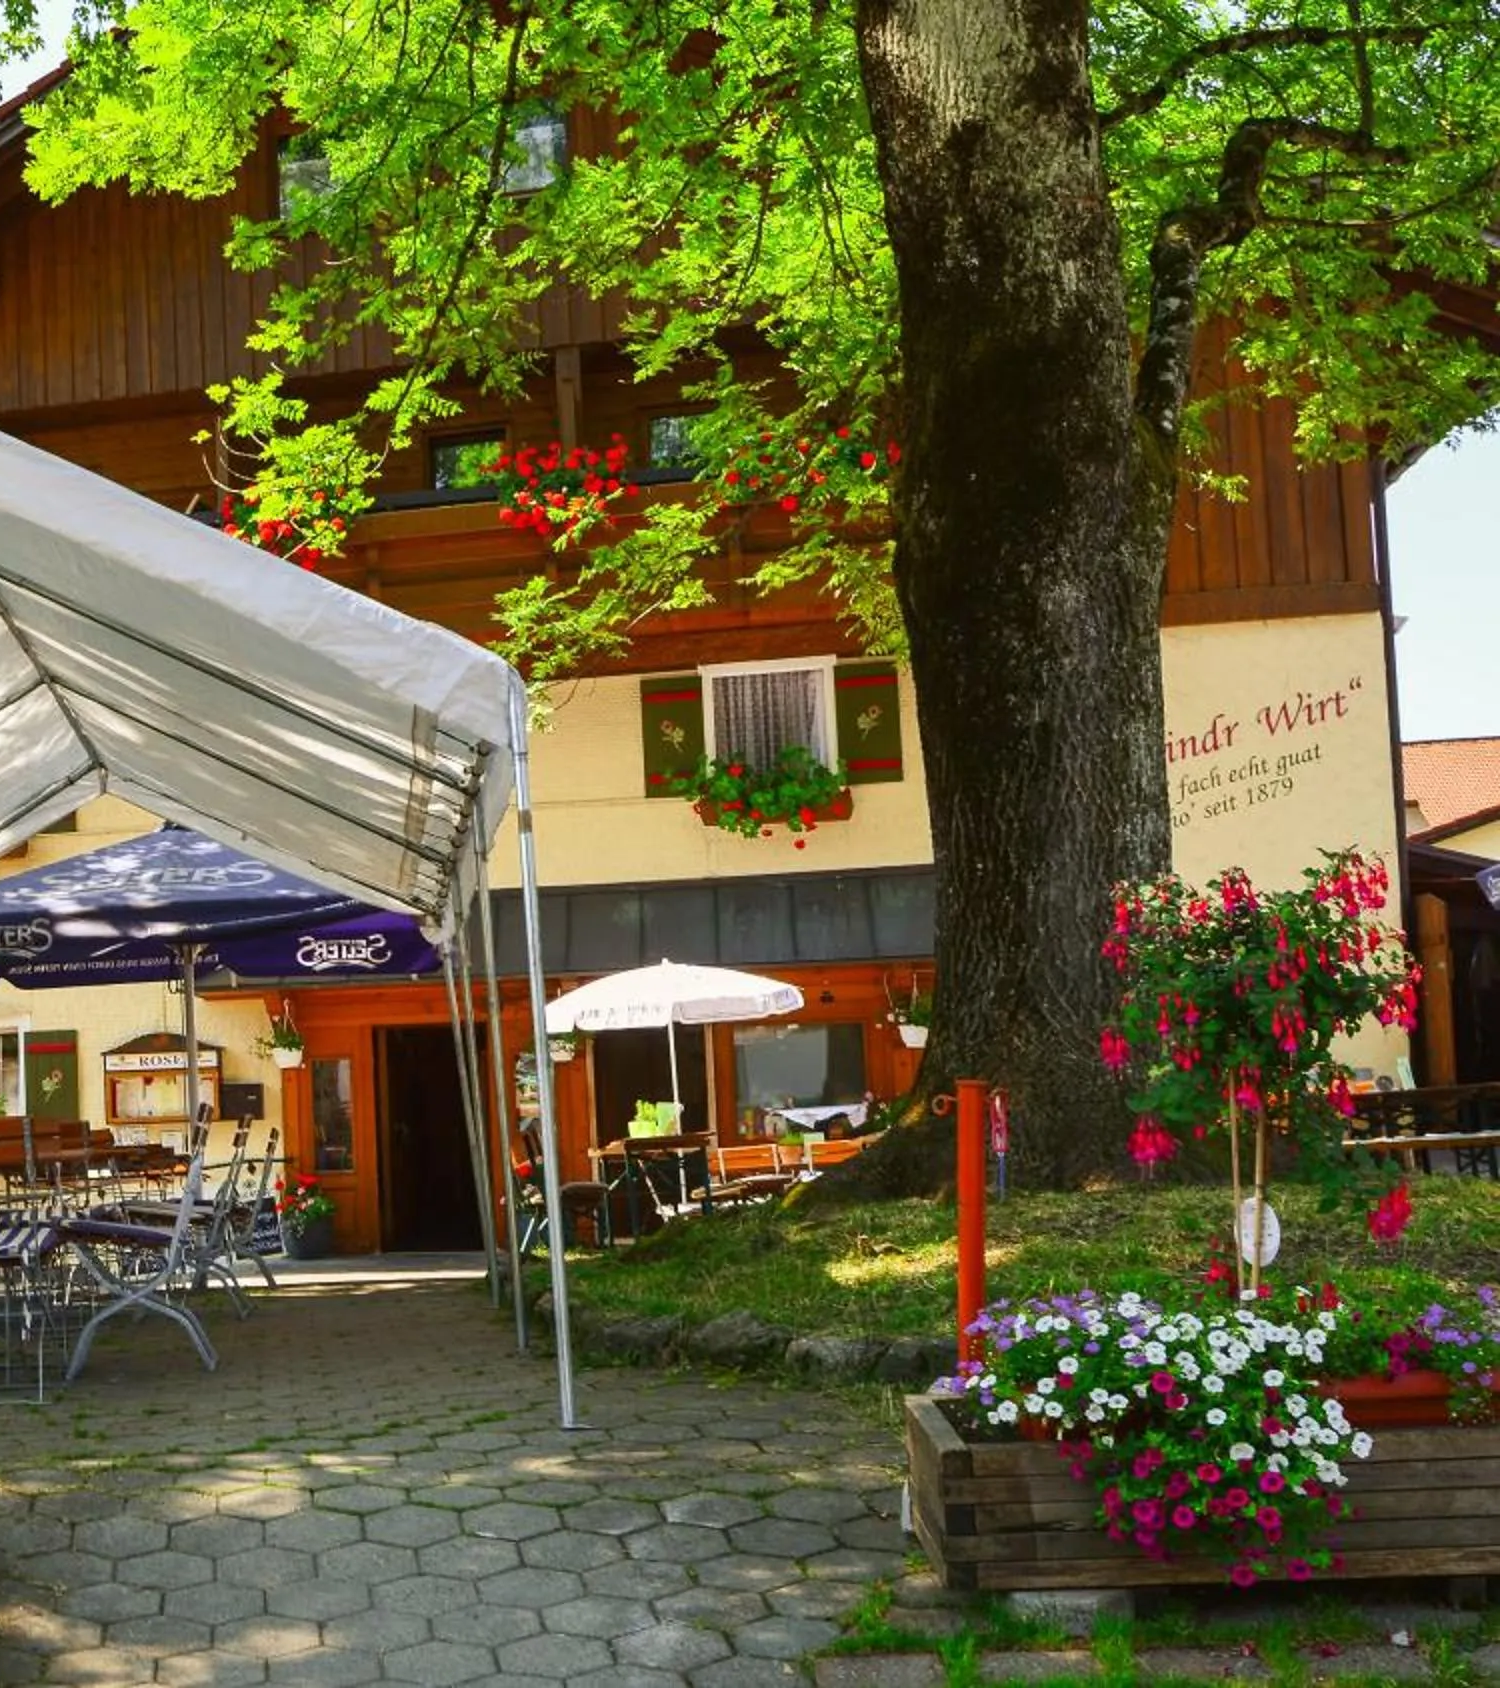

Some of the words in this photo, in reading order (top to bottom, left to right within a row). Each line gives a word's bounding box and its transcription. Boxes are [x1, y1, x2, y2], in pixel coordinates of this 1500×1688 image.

[1229, 755, 1270, 783] echt
[1276, 744, 1322, 776] guat
[1204, 793, 1237, 819] seit
[1248, 776, 1294, 805] 1879
